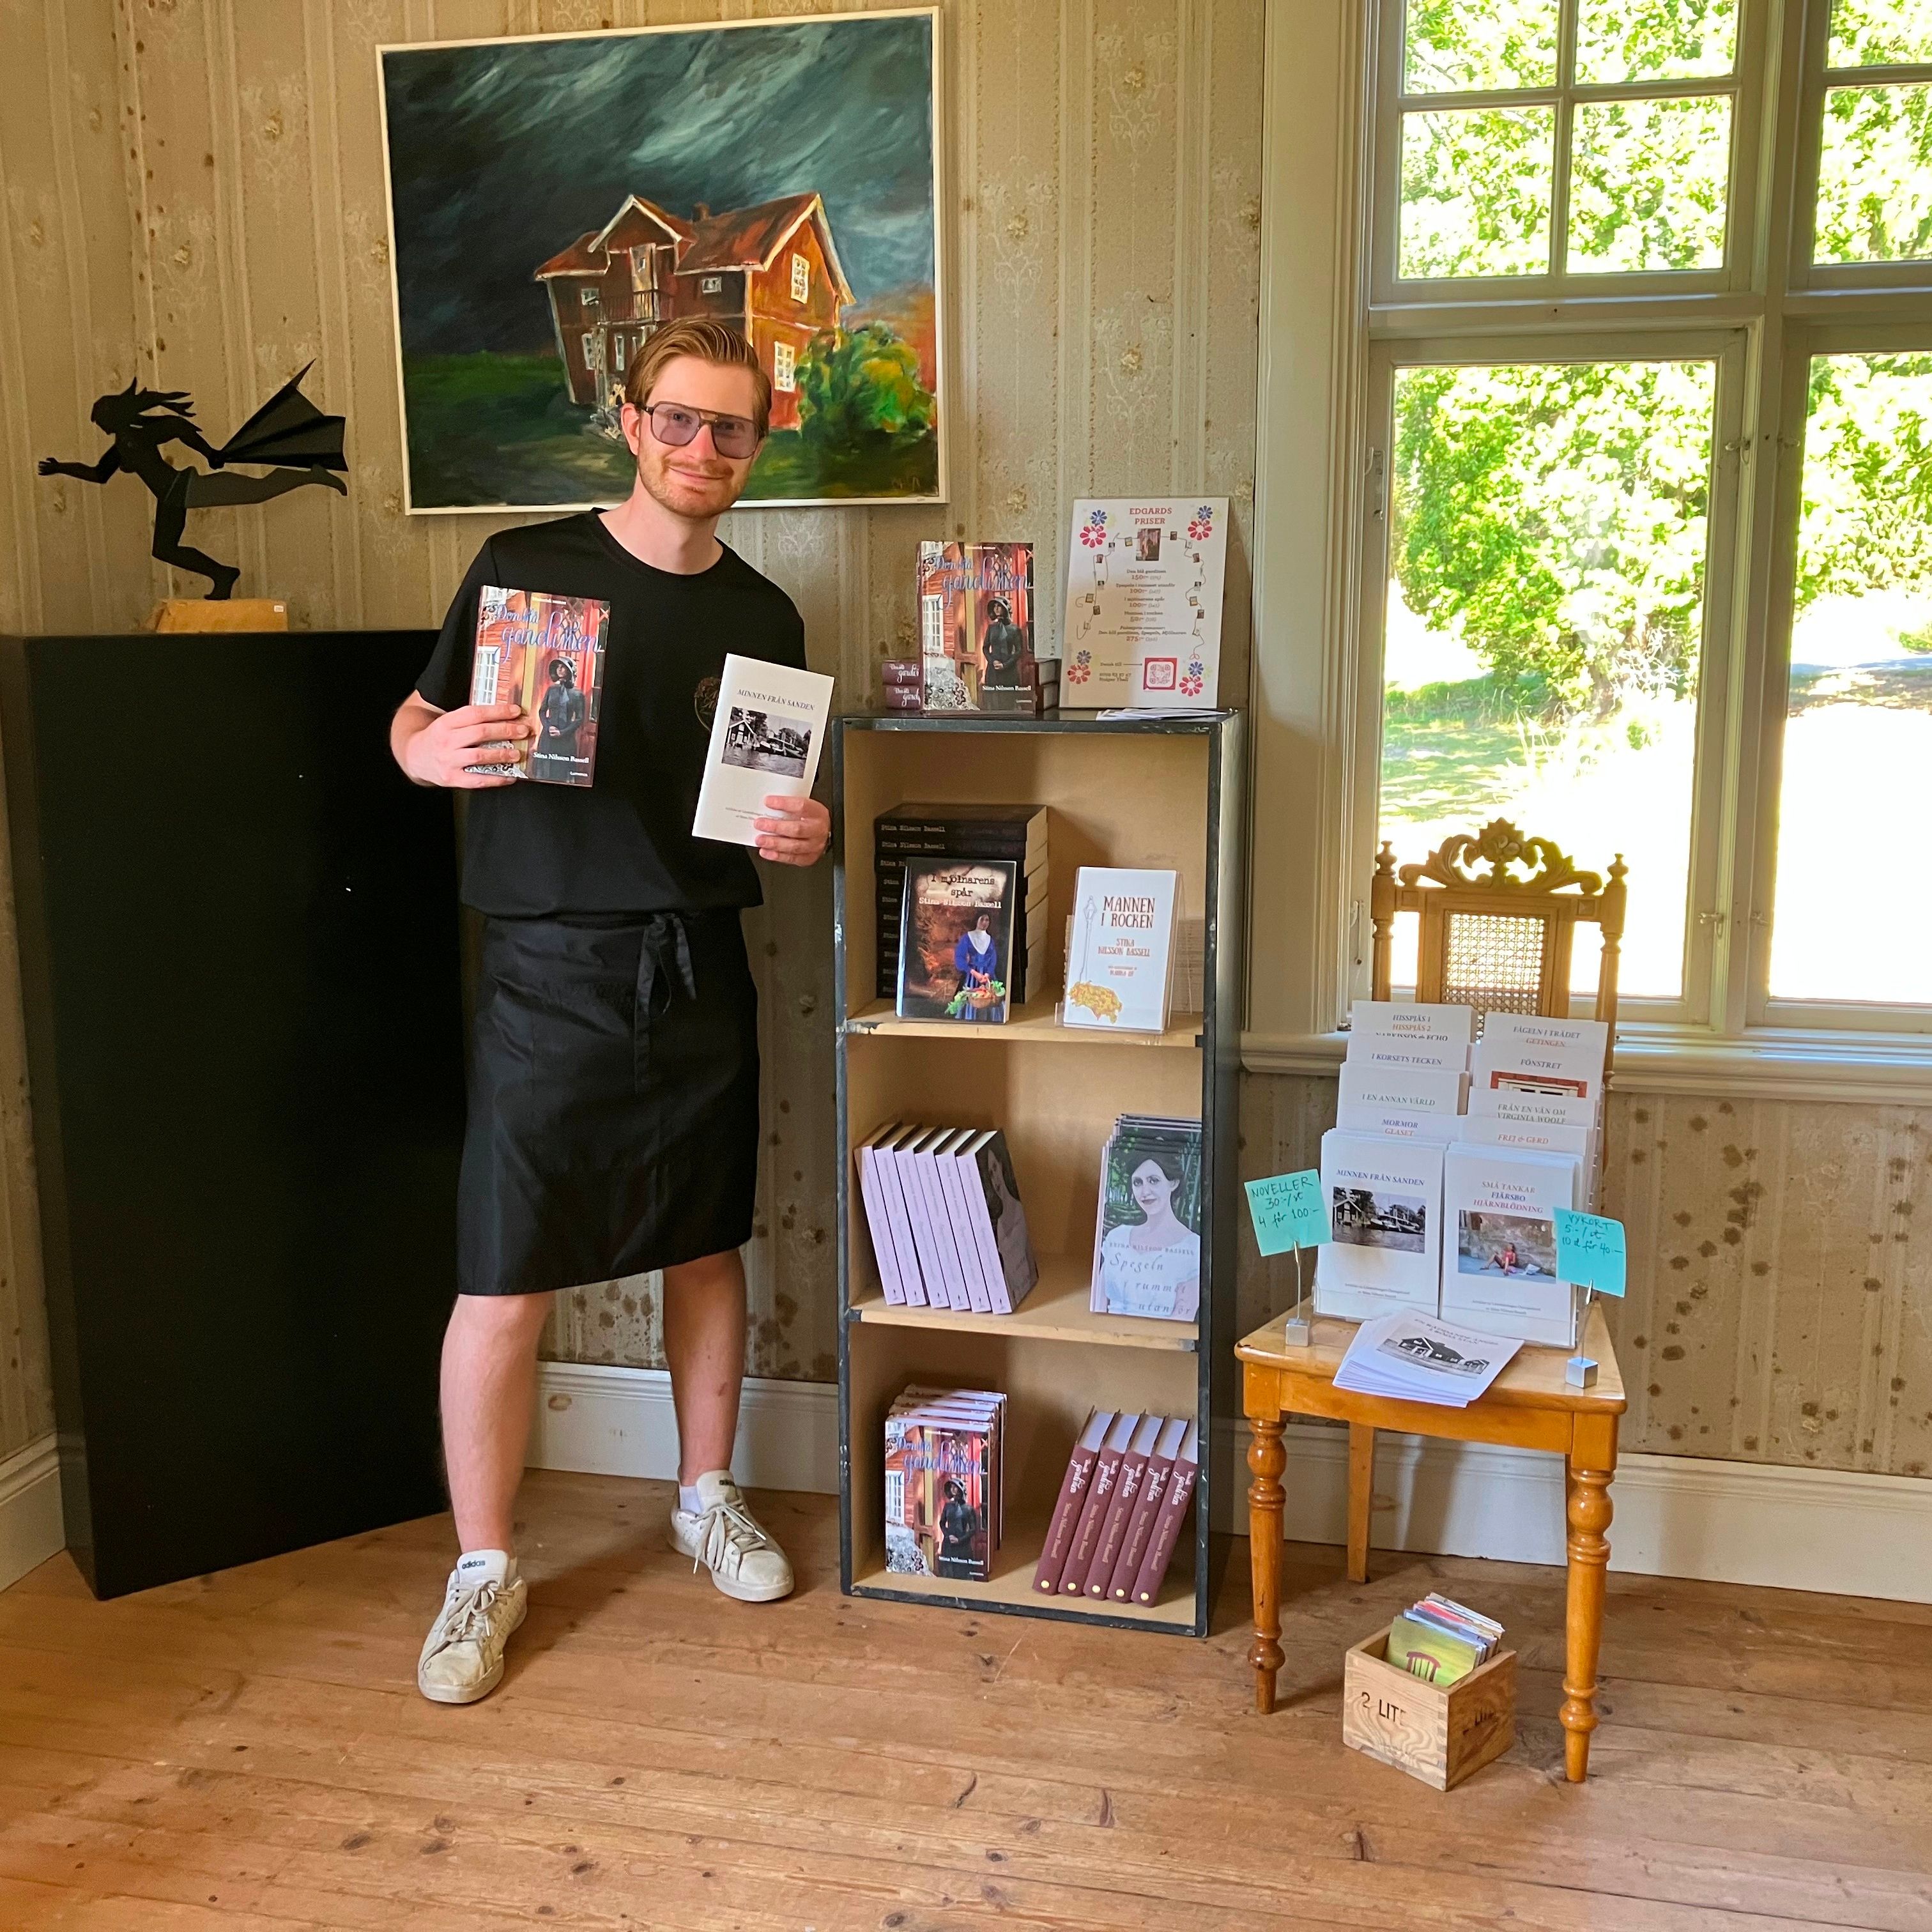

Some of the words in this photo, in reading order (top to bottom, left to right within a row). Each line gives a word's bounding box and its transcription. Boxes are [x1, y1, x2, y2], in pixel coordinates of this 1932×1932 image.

[937, 556, 1031, 610] gardinen
[493, 610, 605, 664] gardinen
[737, 689, 766, 700] MINNEN
[767, 695, 786, 705] FRÅN
[787, 700, 815, 710] SANDEN
[931, 873, 936, 882] I
[941, 875, 995, 885] mjölnarens
[951, 887, 973, 898] spår
[919, 897, 940, 905] Stina
[943, 899, 972, 907] Nilsson
[1103, 896, 1155, 913] MANNEN
[1101, 913, 1105, 926] I
[1111, 913, 1154, 928] ROCKEN
[1116, 939, 1135, 947] STINA
[1098, 946, 1124, 955] NILSSON
[1126, 948, 1150, 957] BASSELL
[1393, 1014, 1426, 1022] HISSPJÄS
[1393, 1023, 1425, 1032] HISSPJÄS
[1513, 1025, 1542, 1036] FÅGELN
[1549, 1030, 1581, 1039] TRÄDET
[1526, 1038, 1567, 1047] GETINGEN
[1376, 1054, 1409, 1063] KORSETS
[1412, 1057, 1443, 1065] TECKEN
[1521, 1059, 1562, 1069] FÖNSTRET
[1379, 1095, 1407, 1103] ANNAN
[1409, 1096, 1436, 1106] VÄRLD
[1498, 1103, 1520, 1112] FRÅN
[1535, 1106, 1552, 1114] VÄN
[1382, 1119, 1418, 1128] MORMOR
[1498, 1112, 1534, 1123] VIRGINIA
[1537, 1116, 1567, 1124] WOOLF
[1384, 1128, 1414, 1136] GLASET
[1498, 1134, 1516, 1142] FREJ
[1336, 1169, 1369, 1179] MINNEN
[1370, 1172, 1391, 1182] FRÅN
[1392, 1176, 1425, 1186] SANDEN
[1252, 1176, 1314, 1198] NOVELLER
[1482, 1181, 1499, 1189] SMÅ
[1502, 1183, 1536, 1193] TANKAR
[1491, 1192, 1526, 1201] FJÄRSBO
[1473, 1199, 1544, 1213] HJÄRNBLÖDNING
[1258, 1215, 1267, 1228] 4
[1272, 1211, 1287, 1228] för
[1568, 1214, 1615, 1230] VYKORT
[1562, 1237, 1572, 1245] 10
[1582, 1240, 1598, 1254] för
[1165, 1248, 1195, 1256] BASSELL
[1109, 1252, 1163, 1273] Spegeln
[903, 1440, 985, 1485] gardinen
[462, 1560, 486, 1570] adidas
[1361, 1692, 1370, 1709] 2
